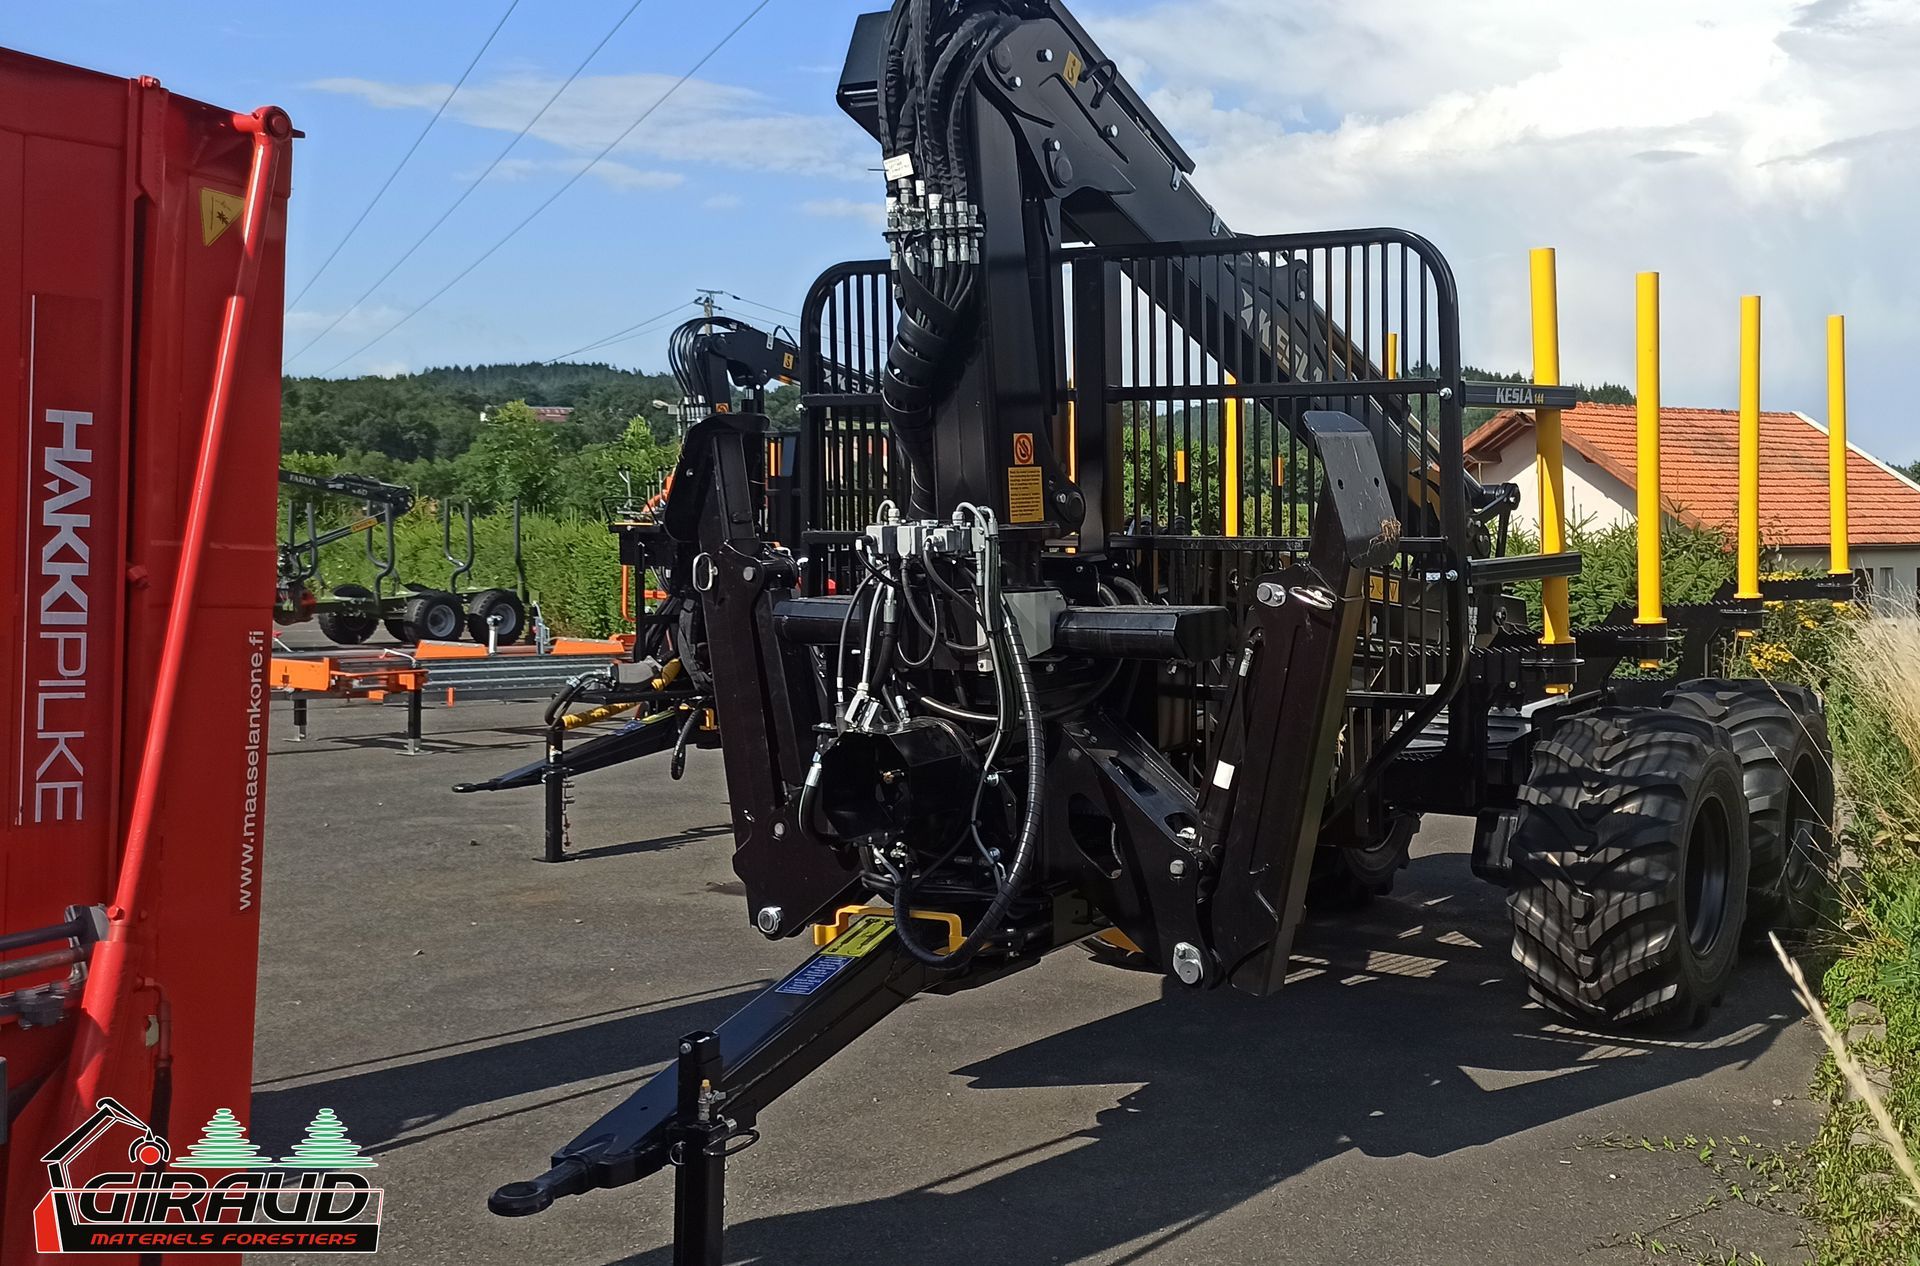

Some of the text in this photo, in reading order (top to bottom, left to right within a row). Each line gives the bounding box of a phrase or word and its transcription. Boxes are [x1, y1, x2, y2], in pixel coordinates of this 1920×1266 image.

[1495, 387, 1533, 404] KESLA
[289, 474, 317, 486] FARMA
[34, 408, 94, 823] HAKKIPILKE
[238, 629, 265, 912] www.maaselankone.fi
